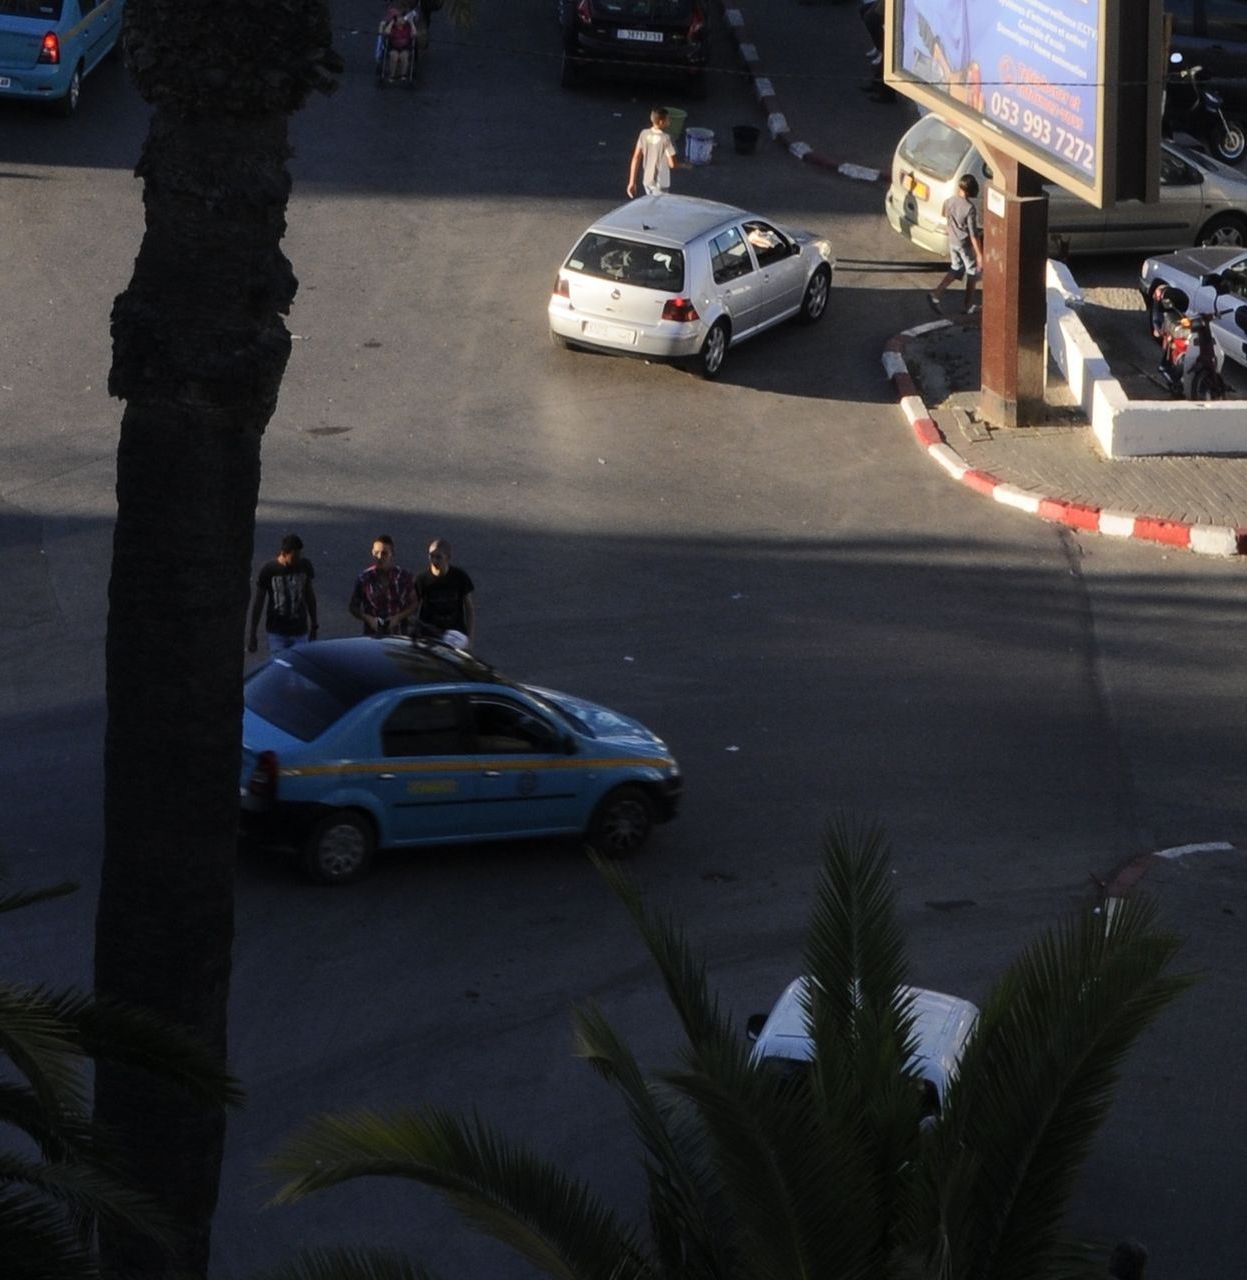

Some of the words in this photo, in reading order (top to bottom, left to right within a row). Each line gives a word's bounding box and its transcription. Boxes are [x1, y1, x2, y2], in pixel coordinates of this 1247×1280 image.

[991, 91, 1019, 127] 053
[1023, 109, 1051, 144] 993
[1055, 127, 1094, 169] 7272
